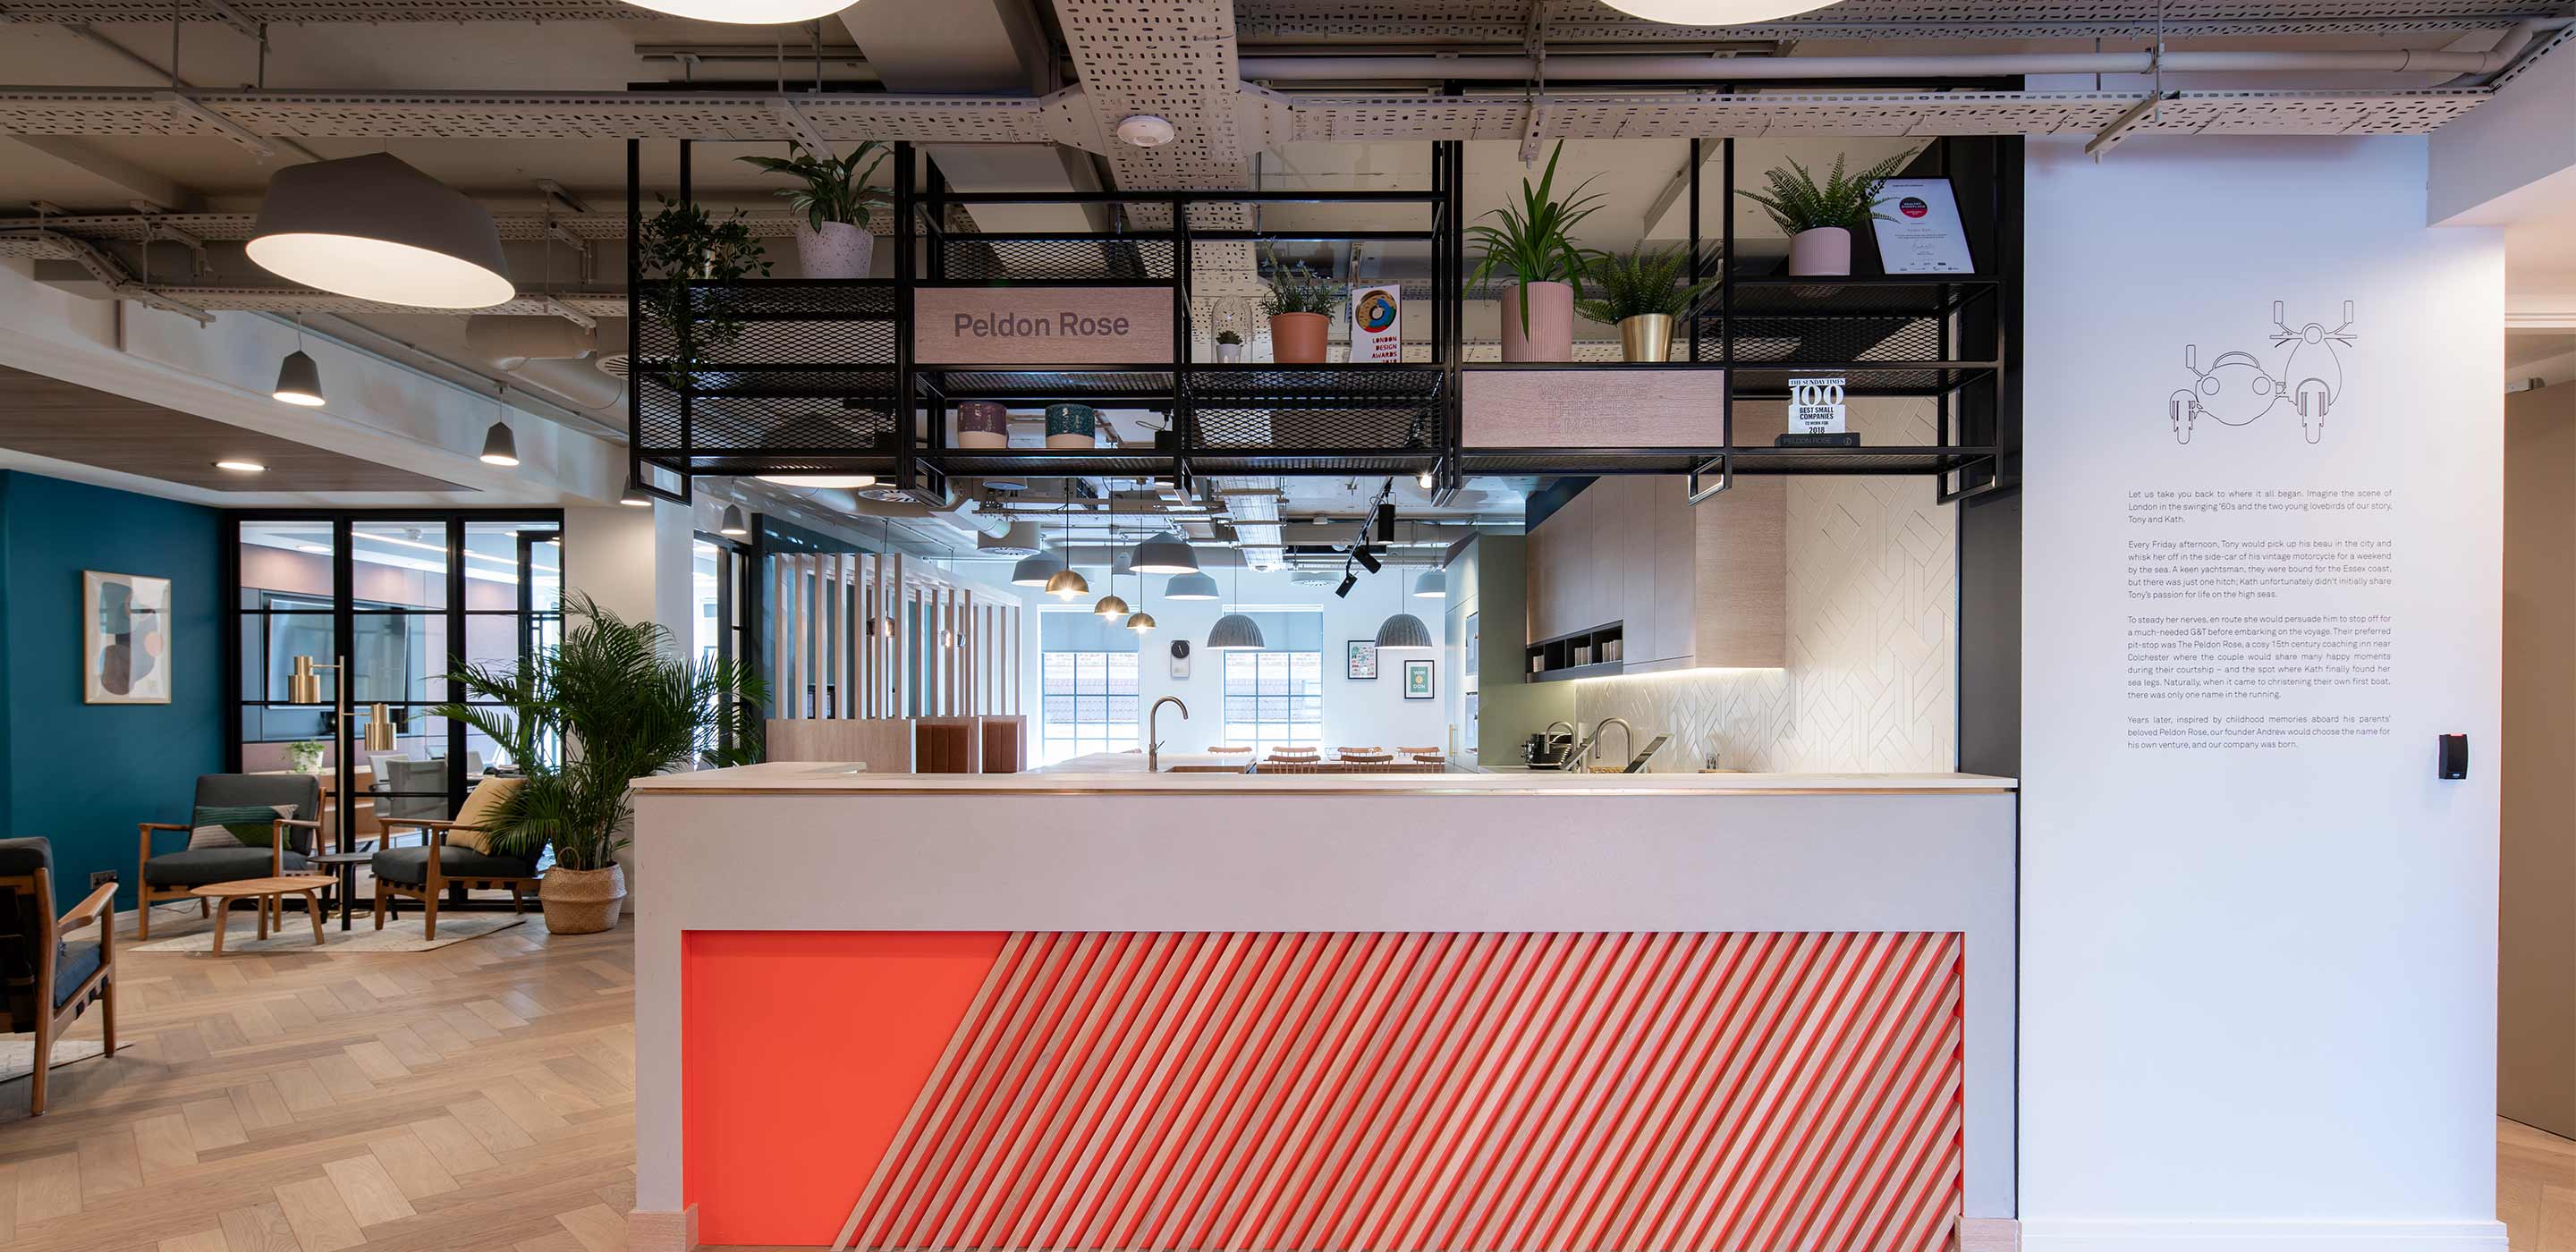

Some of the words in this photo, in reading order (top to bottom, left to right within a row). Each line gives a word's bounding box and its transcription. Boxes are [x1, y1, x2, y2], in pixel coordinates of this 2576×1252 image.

[954, 312, 1050, 337] Peldon
[1059, 312, 1130, 336] Rose
[1538, 384, 1647, 400] WORKPLACE
[1790, 385, 1844, 407] 100
[2307, 490, 2338, 498] Imagine
[2183, 503, 2218, 512] swinging
[2129, 516, 2146, 524] Tony
[2128, 541, 2150, 549] Every
[2152, 541, 2177, 549] Friday
[2222, 540, 2239, 549] Tony
[2268, 540, 2284, 549] pick
[2360, 540, 2374, 548] city
[2262, 553, 2291, 561] vintage
[2292, 552, 2335, 561] motorcycle
[2128, 566, 2138, 574] by
[2248, 565, 2265, 574] they
[2183, 578, 2198, 587] just
[2260, 578, 2313, 586] unfortunately
[2339, 577, 2367, 586] initially
[2152, 591, 2184, 599] passion
[2238, 590, 2255, 599] high
[2218, 653, 2244, 662] couple
[2326, 653, 2350, 661] happy
[2177, 716, 2209, 724] inspired
[2212, 716, 2222, 724] by
